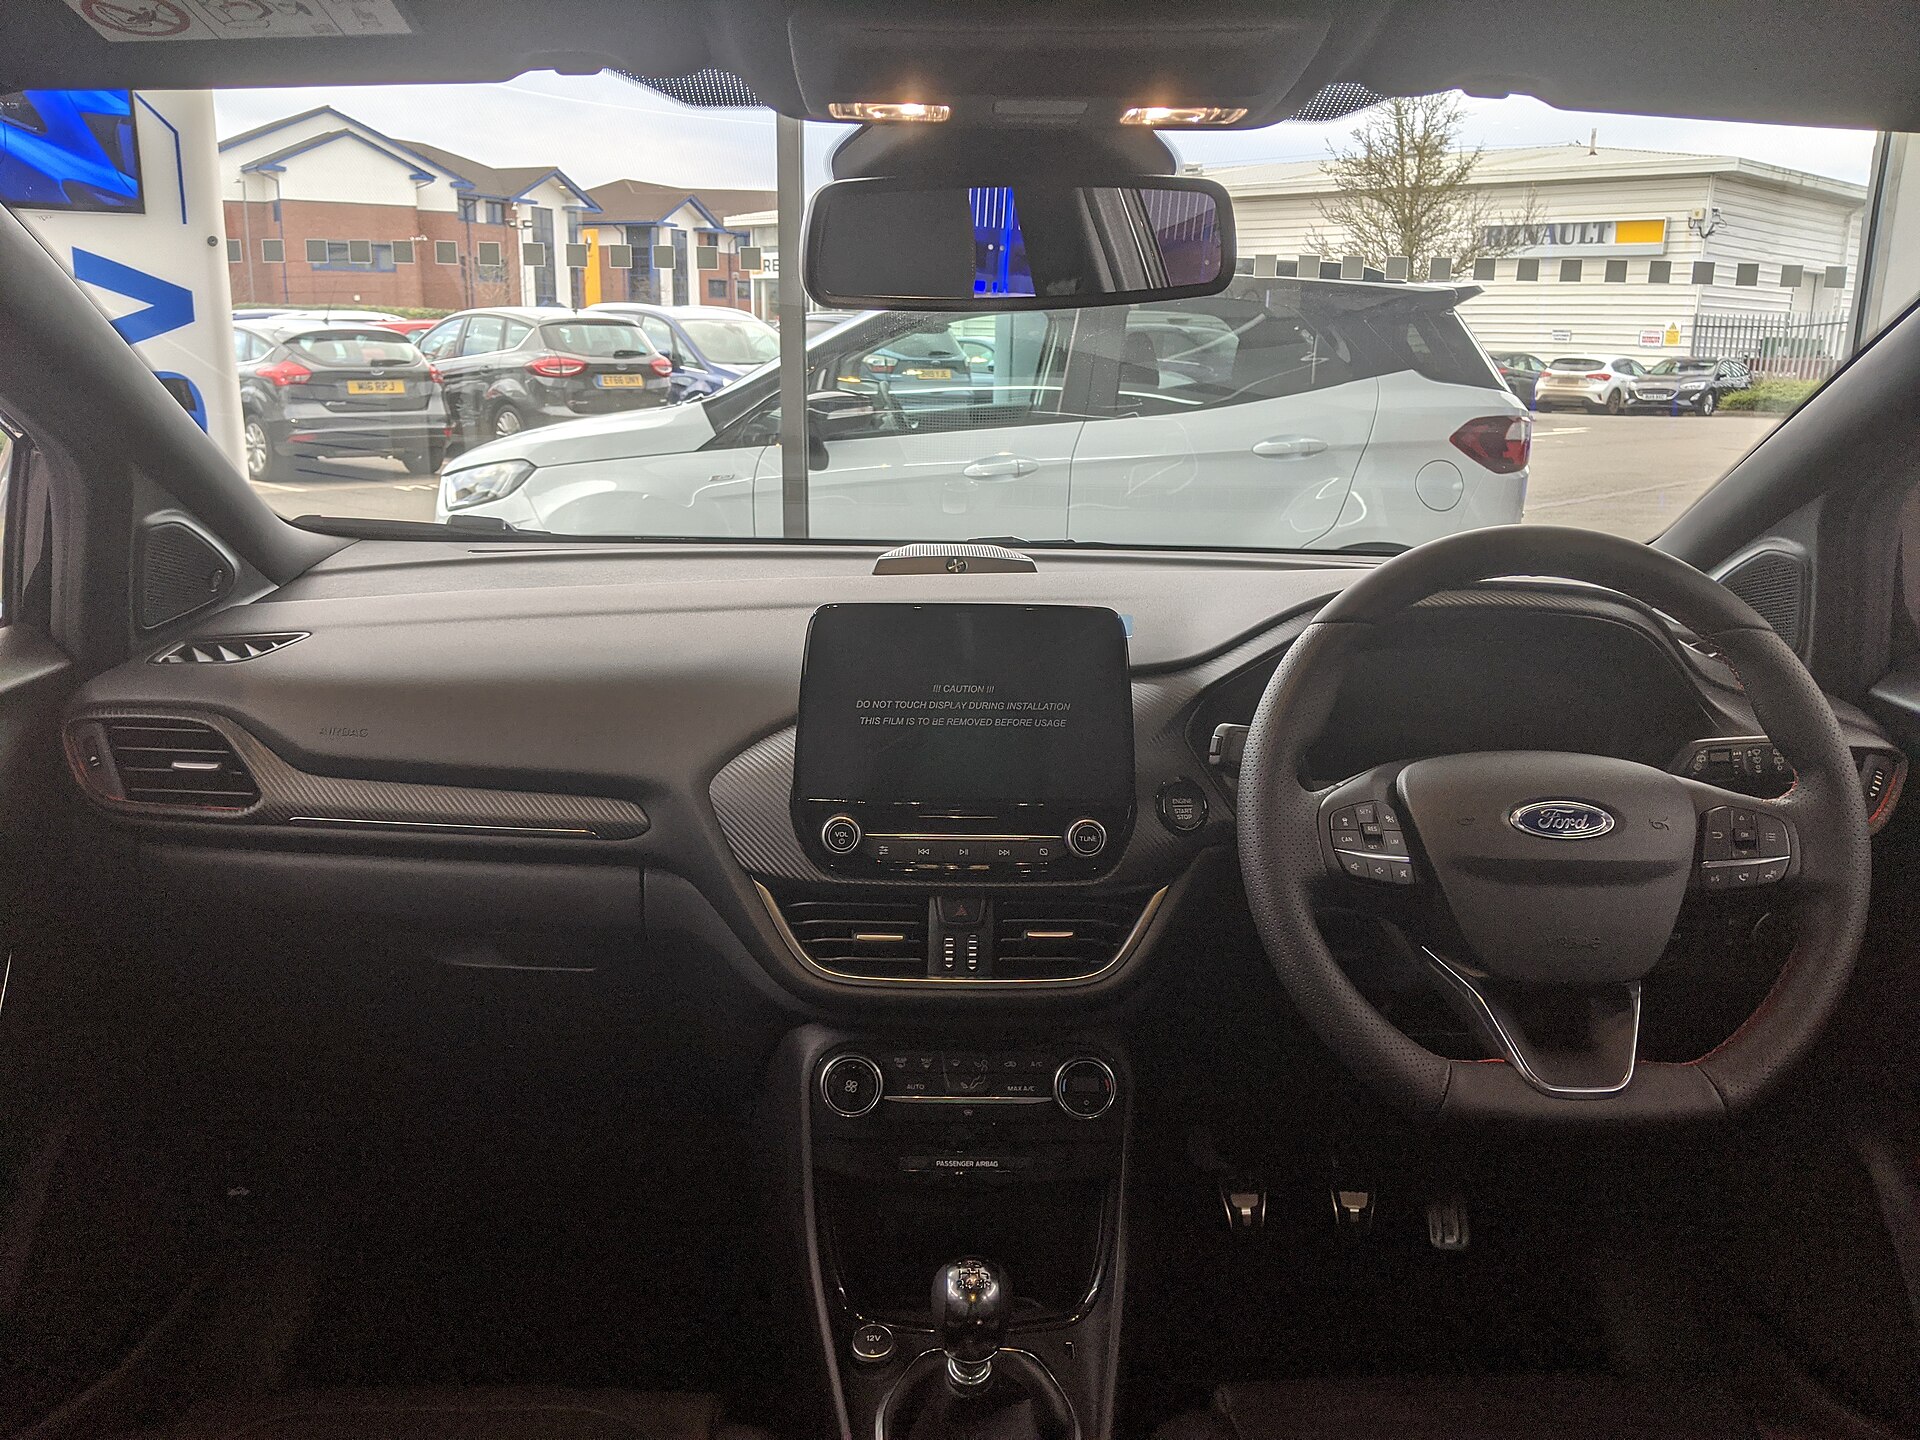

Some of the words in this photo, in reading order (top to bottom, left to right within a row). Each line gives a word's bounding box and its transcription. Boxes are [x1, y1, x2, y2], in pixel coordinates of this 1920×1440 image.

[1485, 222, 1610, 246] RENAULT
[943, 685, 985, 694] CAUTION
[856, 700, 871, 709] DO
[872, 700, 893, 709] NOT
[895, 701, 927, 709] TOUCH
[928, 701, 968, 710] DISPLAY
[968, 702, 1005, 710] DURING
[1006, 702, 1071, 711] INSTALLATION
[860, 717, 881, 725] THIS
[882, 717, 904, 725] FILM
[905, 717, 915, 725] IS
[917, 718, 930, 726] TO
[932, 718, 945, 726] BE
[946, 718, 993, 727] REMOVED
[994, 718, 1032, 727] BEFORE
[1034, 719, 1067, 727] USAGE
[1538, 809, 1590, 830] Ford
[1079, 834, 1097, 843] TUNE
[936, 1160, 974, 1168] PASSENGER
[975, 1160, 999, 1168] AIRBAG
